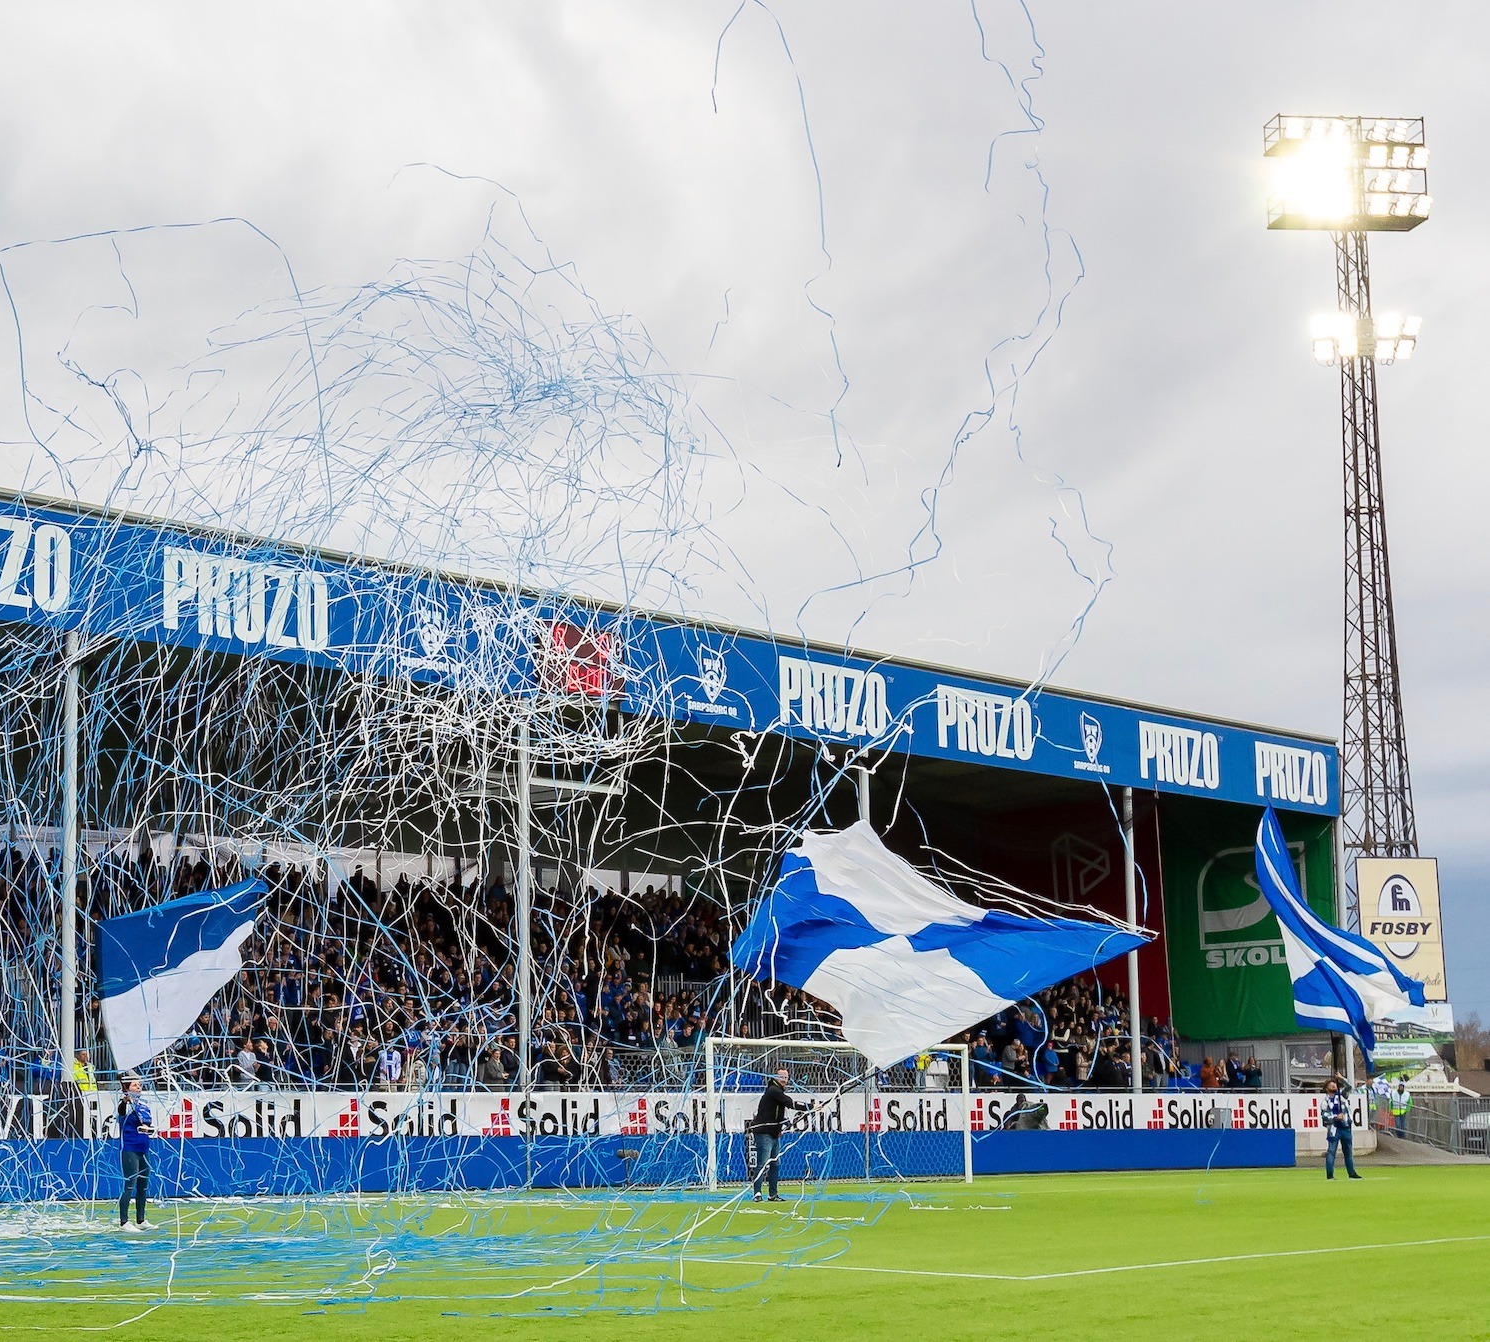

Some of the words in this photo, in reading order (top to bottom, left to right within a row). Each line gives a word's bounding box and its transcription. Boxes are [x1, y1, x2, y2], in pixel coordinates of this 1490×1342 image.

[163, 545, 328, 651] PRUZO
[779, 655, 887, 738] PRUZO
[937, 684, 1033, 761] PRUZO
[1139, 720, 1220, 790] PRUZO
[1254, 740, 1328, 806] PRUZO
[1370, 922, 1432, 936] FOSBY
[203, 1098, 301, 1138] Solid
[369, 1098, 458, 1137] Solid
[518, 1098, 600, 1136] Solid
[654, 1098, 726, 1134] Solid
[781, 1098, 843, 1132] olid
[887, 1098, 948, 1131] Solid
[1082, 1098, 1134, 1130] Solid
[1248, 1098, 1292, 1129] Solid
